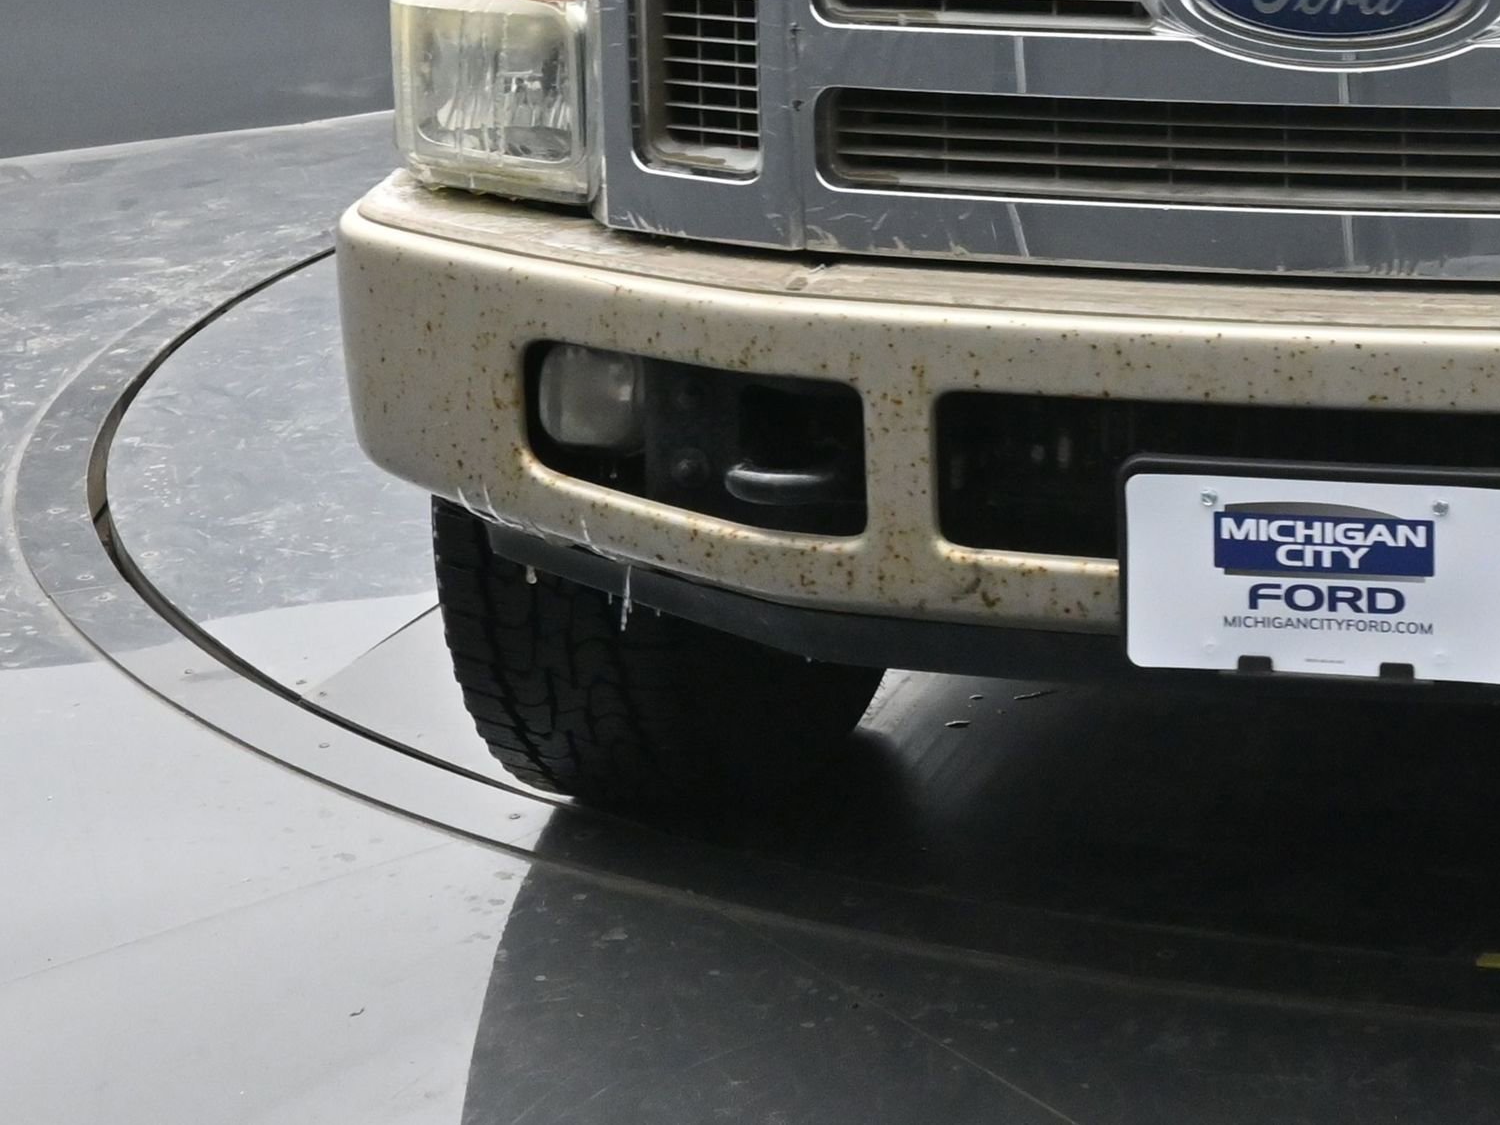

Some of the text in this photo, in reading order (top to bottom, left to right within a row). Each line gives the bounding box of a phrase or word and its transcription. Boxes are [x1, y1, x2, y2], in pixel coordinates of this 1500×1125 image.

[1220, 517, 1428, 548] MICHIGAN
[1275, 544, 1371, 570] CITY
[1247, 583, 1406, 615] FORD
[1223, 616, 1434, 636] MICHIGANCITYFORD.COM
